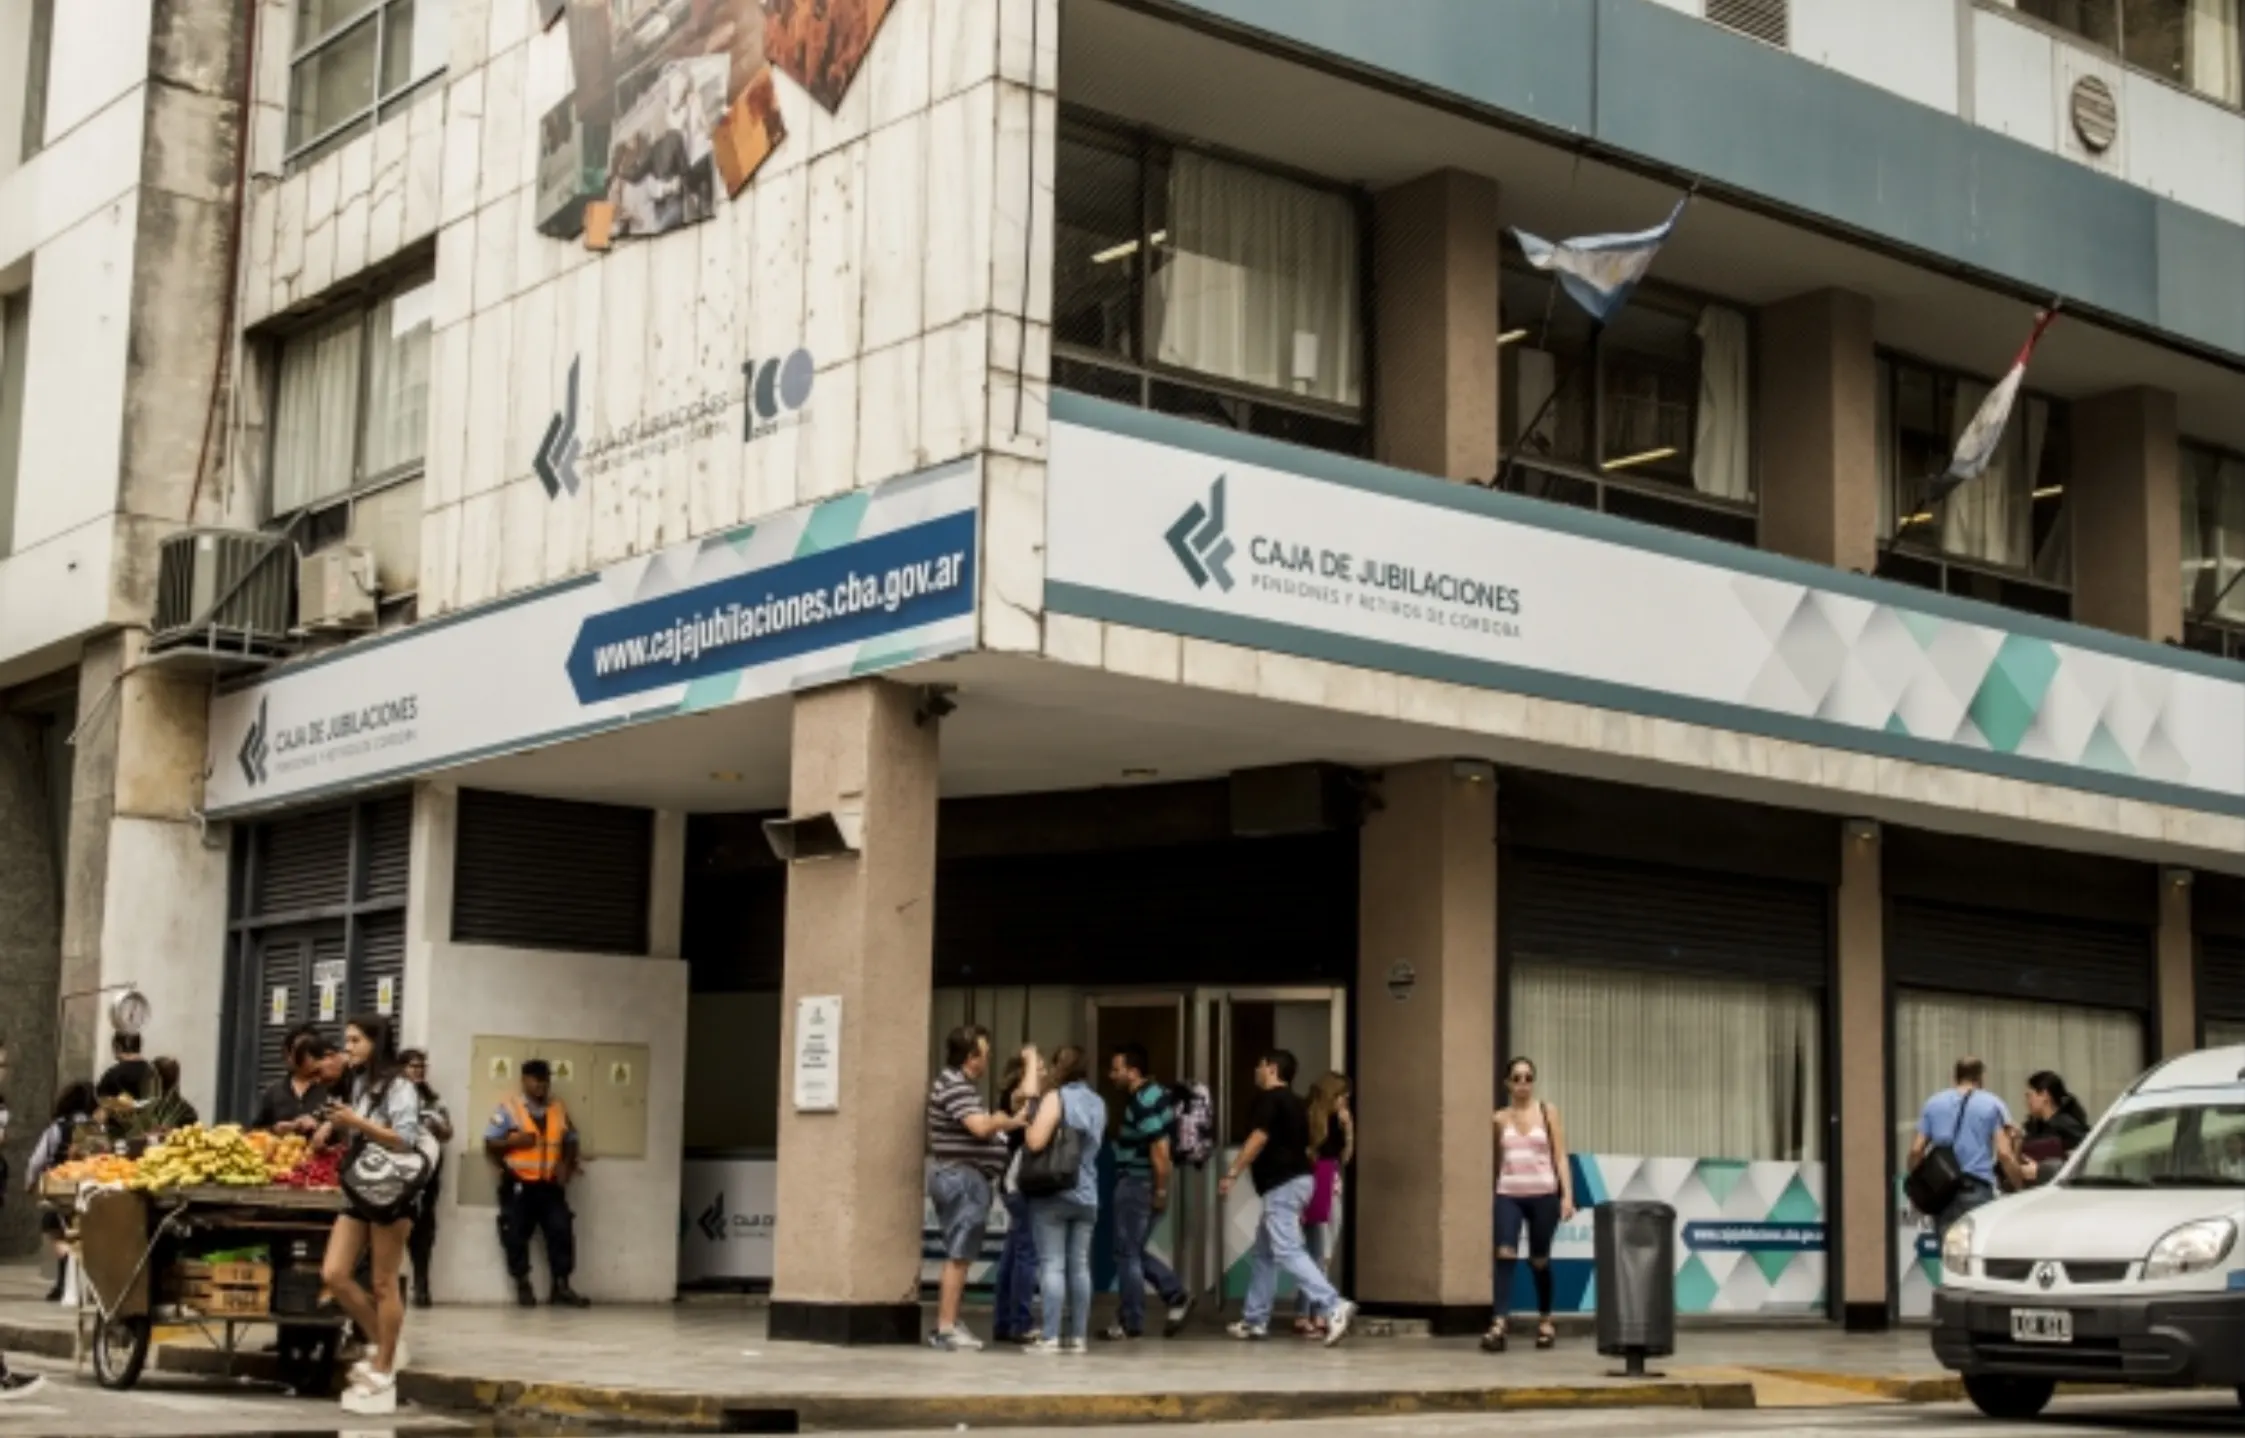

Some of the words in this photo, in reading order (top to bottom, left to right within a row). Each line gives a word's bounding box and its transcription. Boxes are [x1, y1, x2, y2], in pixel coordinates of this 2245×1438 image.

[1249, 535, 1314, 575] CAJA
[1320, 548, 1353, 583] DE
[1356, 558, 1520, 616] JUBILACIONES
[1250, 573, 1340, 604] PENSIONES
[1344, 591, 1354, 607] Y
[593, 550, 964, 677] www.cajajubilaciones.cba.gov.ar
[326, 694, 419, 740] JUBILACIONES
